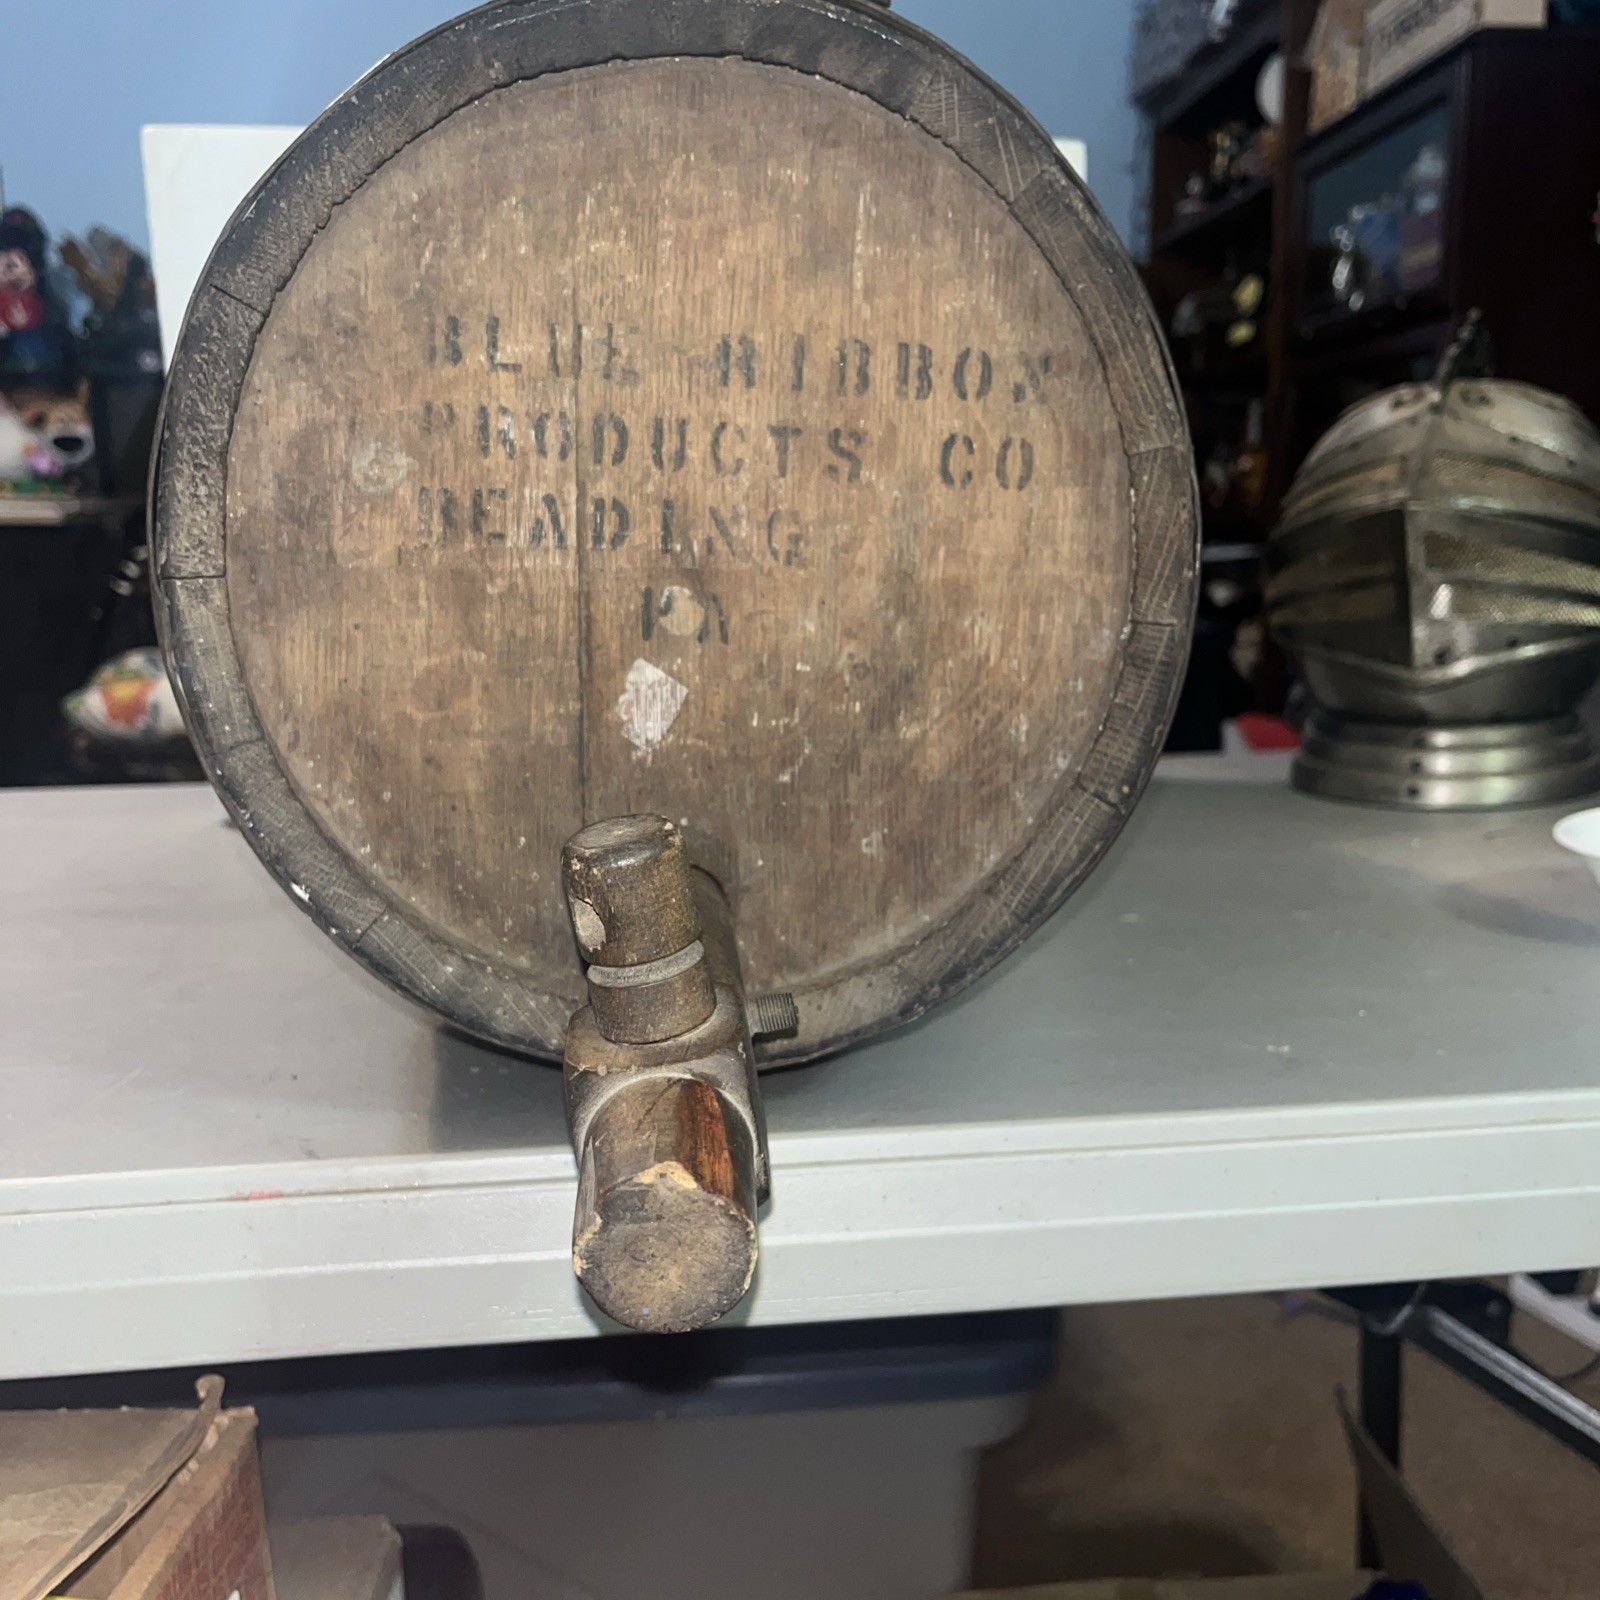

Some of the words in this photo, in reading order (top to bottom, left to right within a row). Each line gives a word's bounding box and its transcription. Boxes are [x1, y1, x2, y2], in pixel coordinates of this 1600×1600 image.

[426, 313, 642, 386] BLUE
[714, 332, 1050, 403] RIBBON
[424, 399, 865, 483] PRODUCTS
[939, 432, 1034, 491] CO
[417, 485, 803, 567] READING
